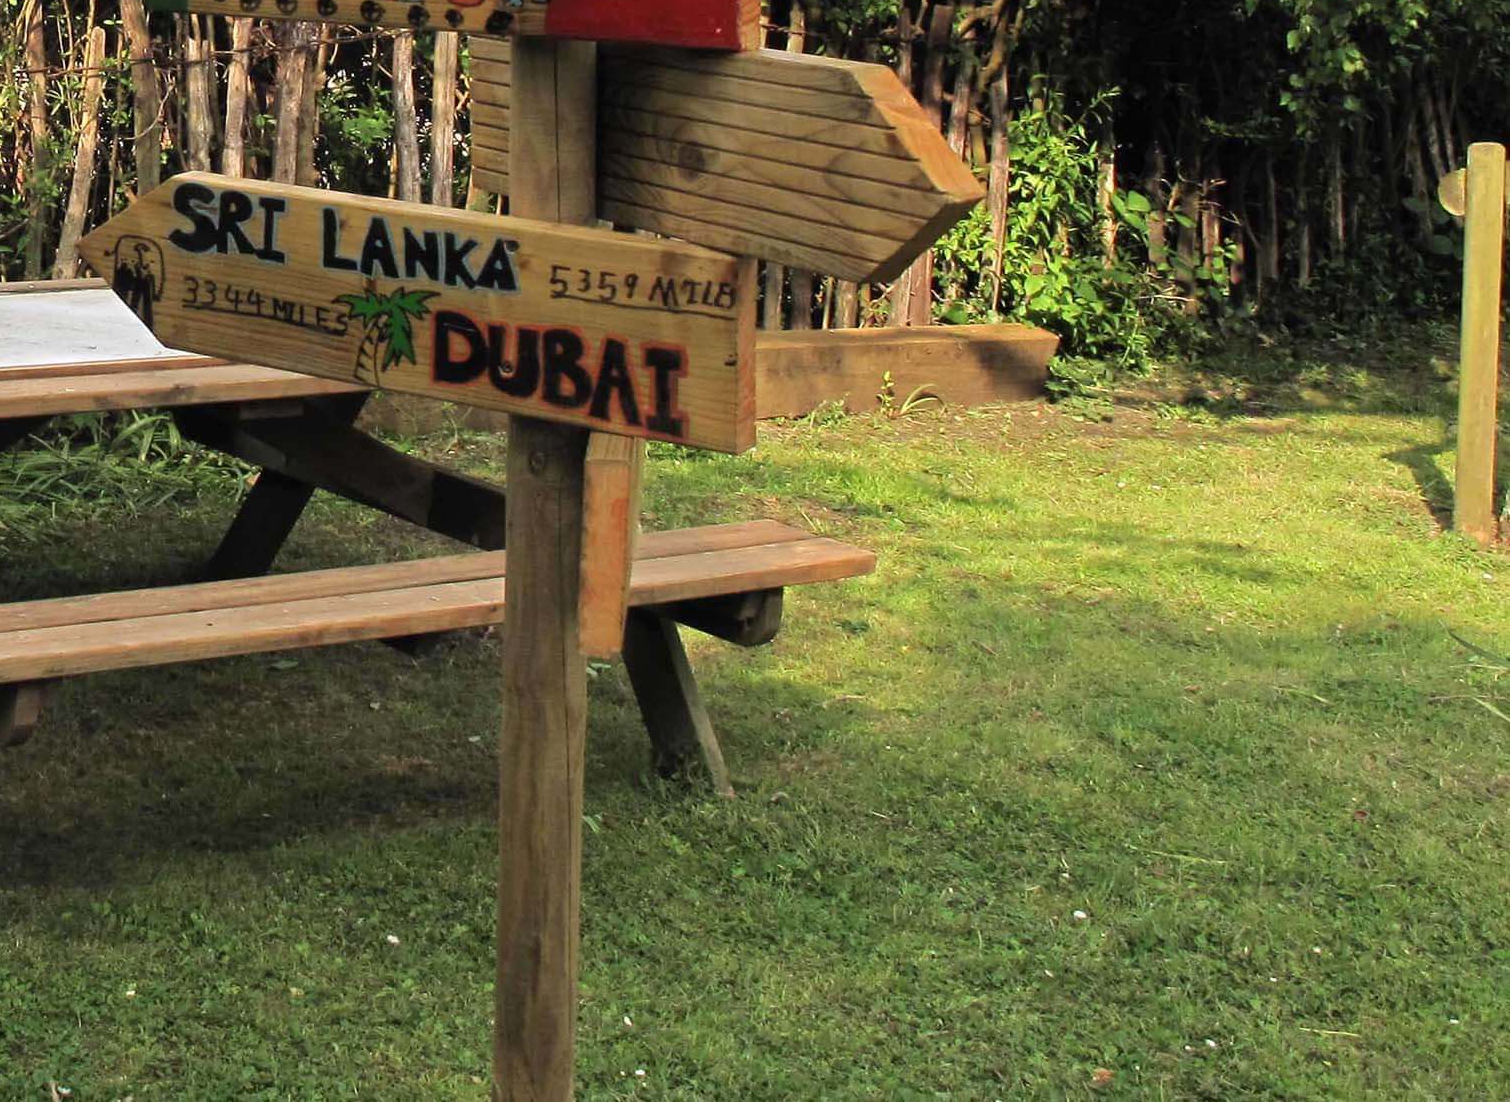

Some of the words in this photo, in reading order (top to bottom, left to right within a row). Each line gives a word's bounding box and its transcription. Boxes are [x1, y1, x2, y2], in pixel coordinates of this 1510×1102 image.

[168, 182, 286, 265] SRI
[322, 207, 521, 292] LANKA
[182, 275, 266, 316] 3344
[271, 297, 349, 336] MILES
[549, 264, 640, 303] 5359
[429, 308, 690, 441] DUBAI
